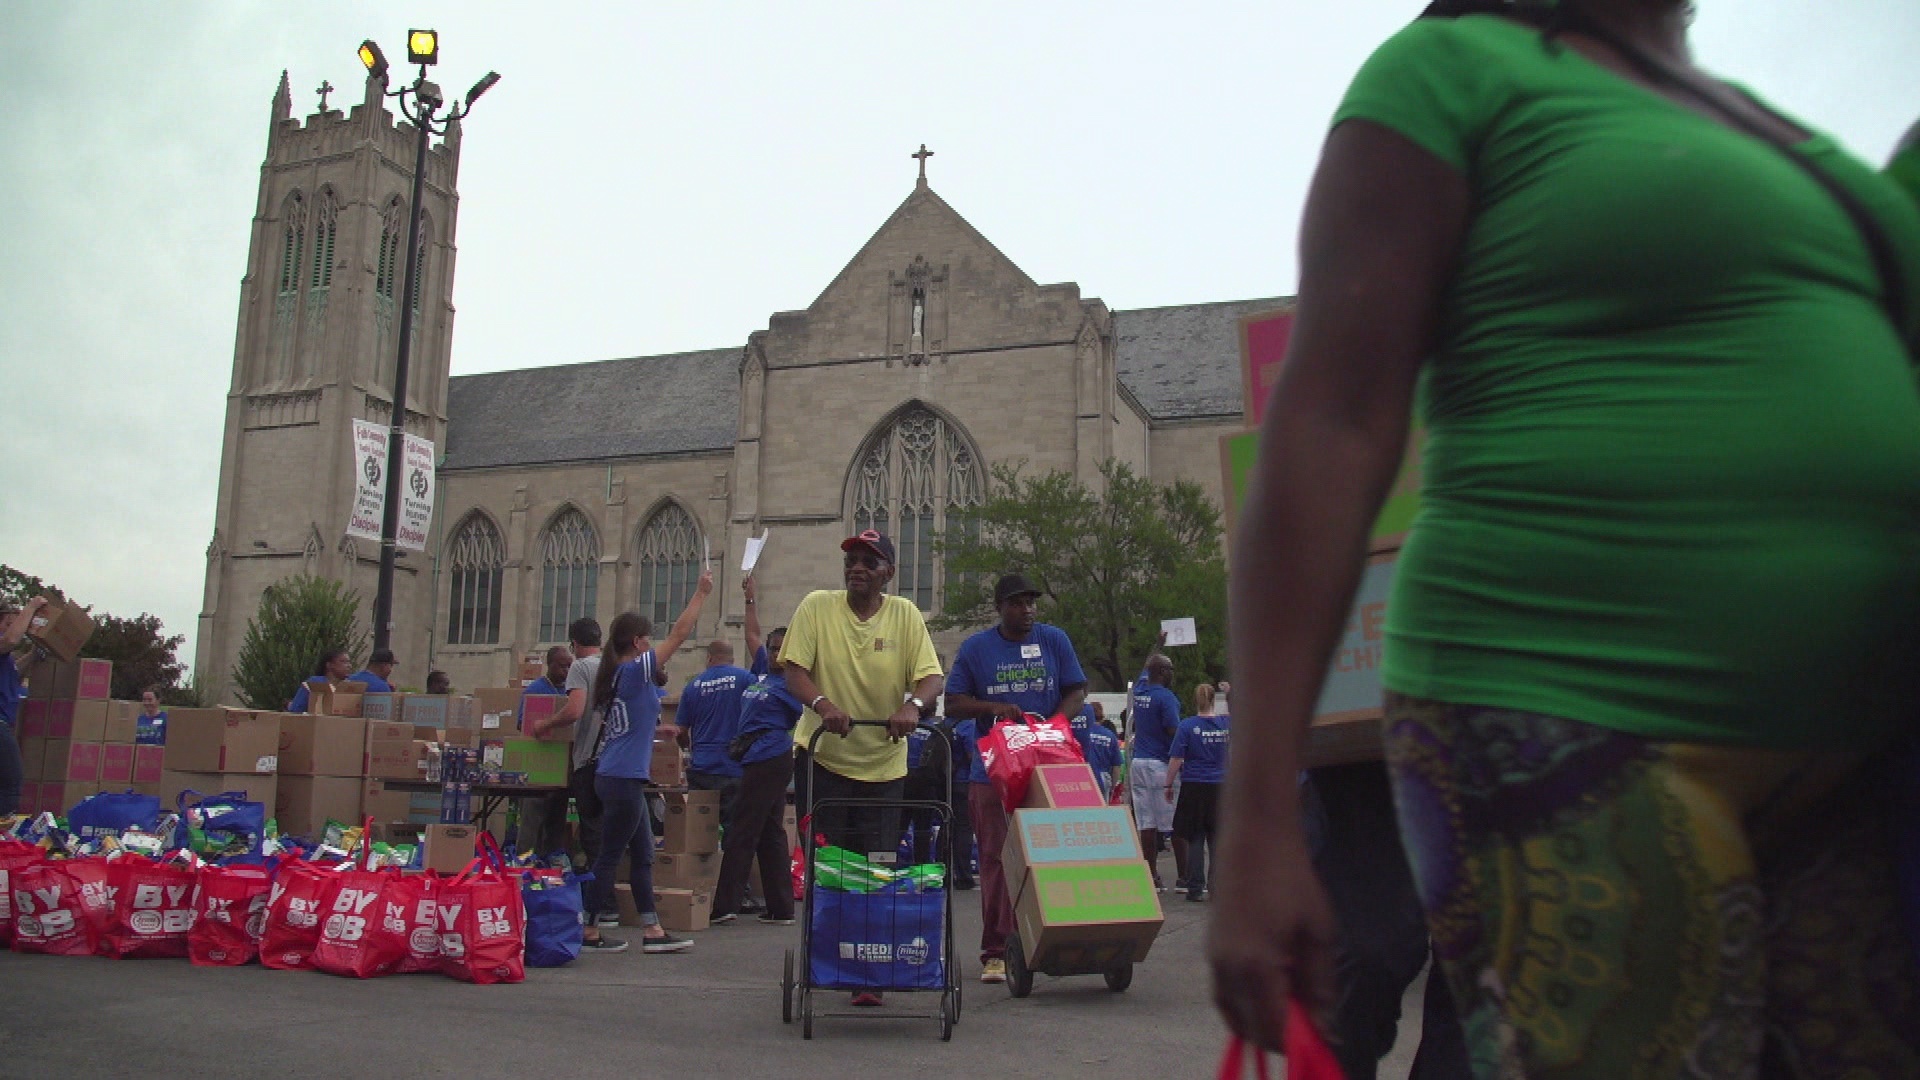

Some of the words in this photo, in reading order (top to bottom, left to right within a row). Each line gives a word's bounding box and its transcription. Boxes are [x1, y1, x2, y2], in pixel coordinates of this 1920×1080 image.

[1061, 821, 1111, 837] FEED
[1063, 835, 1123, 847] CHILDREN
[15, 884, 61, 915] BY
[133, 884, 188, 908] BY
[290, 896, 321, 913] BY
[332, 888, 378, 915] BY
[477, 906, 507, 923] BY
[857, 943, 887, 955] FEED
